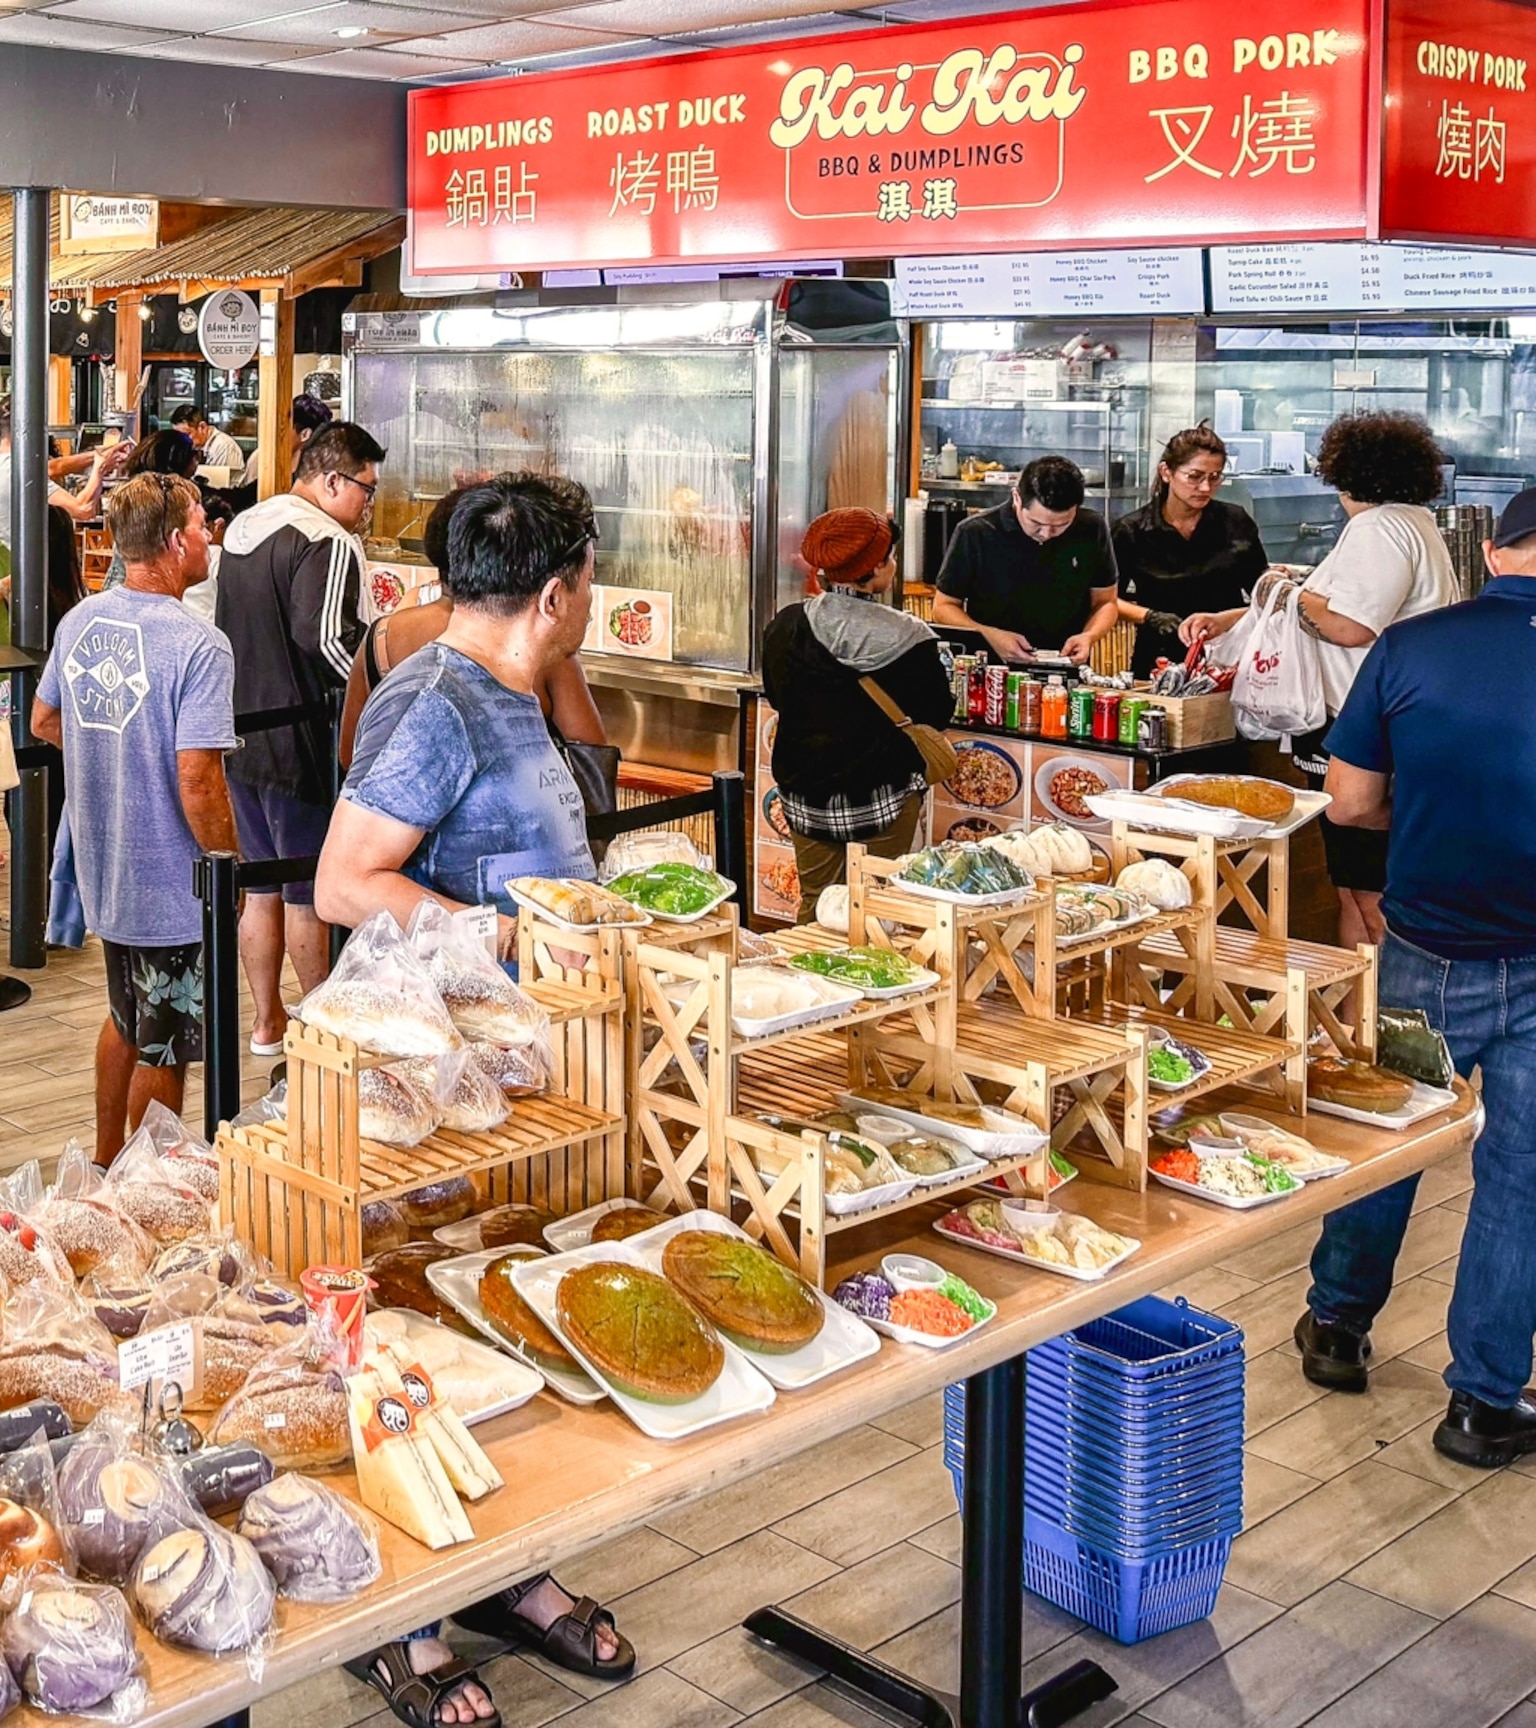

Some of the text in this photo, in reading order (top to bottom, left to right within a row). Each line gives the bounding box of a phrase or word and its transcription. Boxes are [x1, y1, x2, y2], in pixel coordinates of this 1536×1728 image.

[1129, 29, 1340, 84] BBQ PORK
[1417, 41, 1527, 92] CRISPY PORK
[588, 93, 747, 138] ROAST DUCK
[769, 43, 1087, 148] Kai Kai
[426, 117, 554, 157] DUMPLINGS
[1144, 91, 1317, 183] 叉燒
[1435, 99, 1507, 184] 燒肉
[609, 144, 719, 218] 烤鴨
[819, 143, 1024, 177] BBQ & DUMPLINGS
[92, 202, 117, 216] BÁNH
[445, 161, 539, 229] 鍋貼
[877, 177, 957, 222] 淇淇
[1279, 282, 1297, 290] Salad
[1404, 289, 1431, 297] Chinese
[1432, 288, 1461, 296] Sausage
[1421, 272, 1439, 280] Fried
[206, 322, 257, 333] BÁNH MÌ BOY
[210, 345, 252, 355] ORDER HERE
[78, 630, 136, 667] VOLCOM
